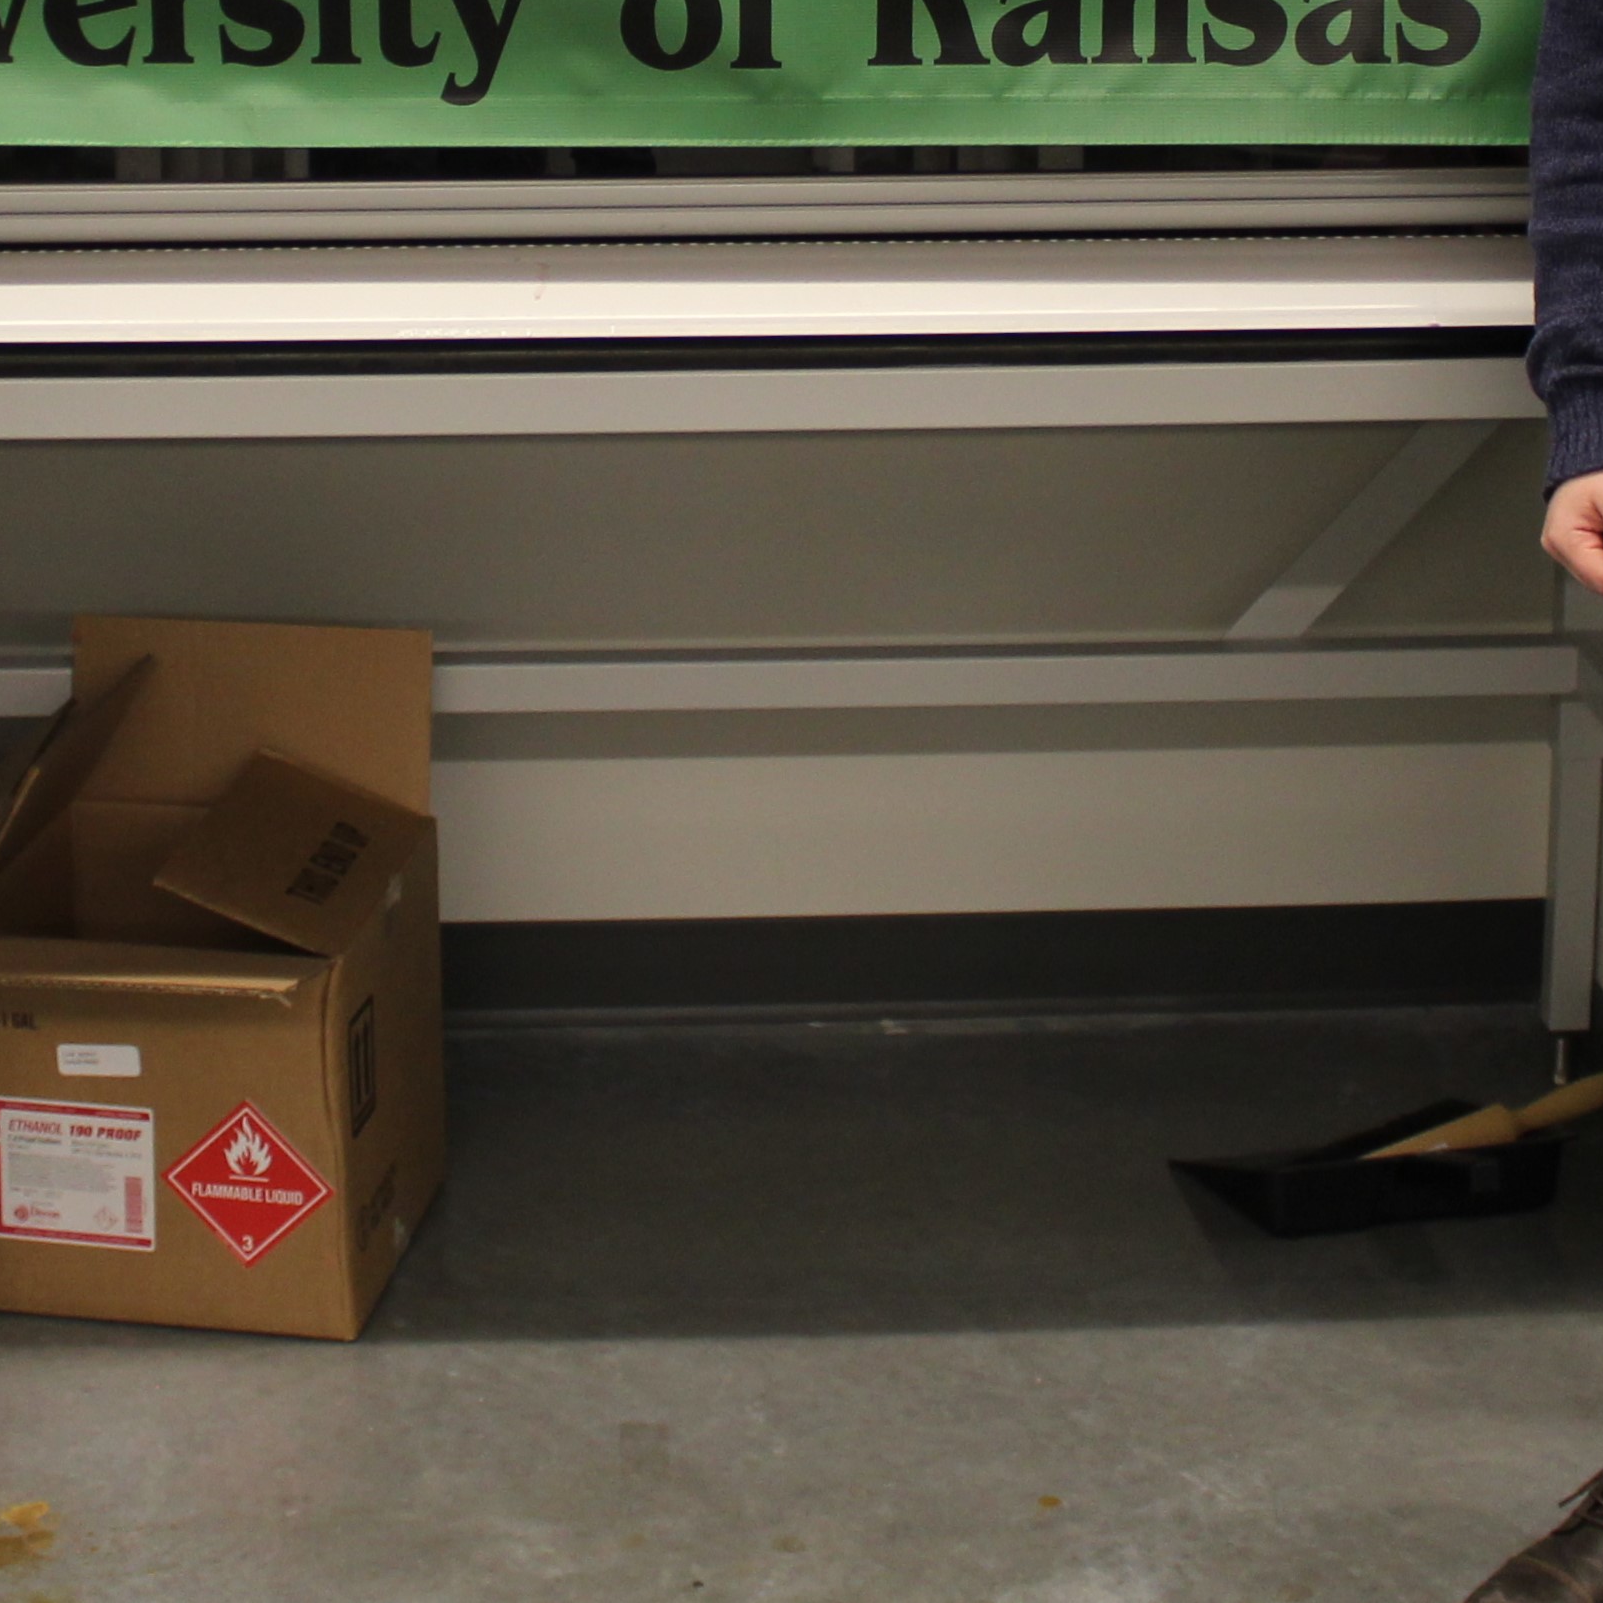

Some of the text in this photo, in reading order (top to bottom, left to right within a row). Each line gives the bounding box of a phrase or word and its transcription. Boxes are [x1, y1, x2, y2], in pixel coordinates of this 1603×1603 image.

[7, 1119, 143, 1142] ETHANOL 190 PROOF
[191, 1182, 304, 1206] FLAMMABLE LIQUID
[241, 1234, 254, 1252] 3
